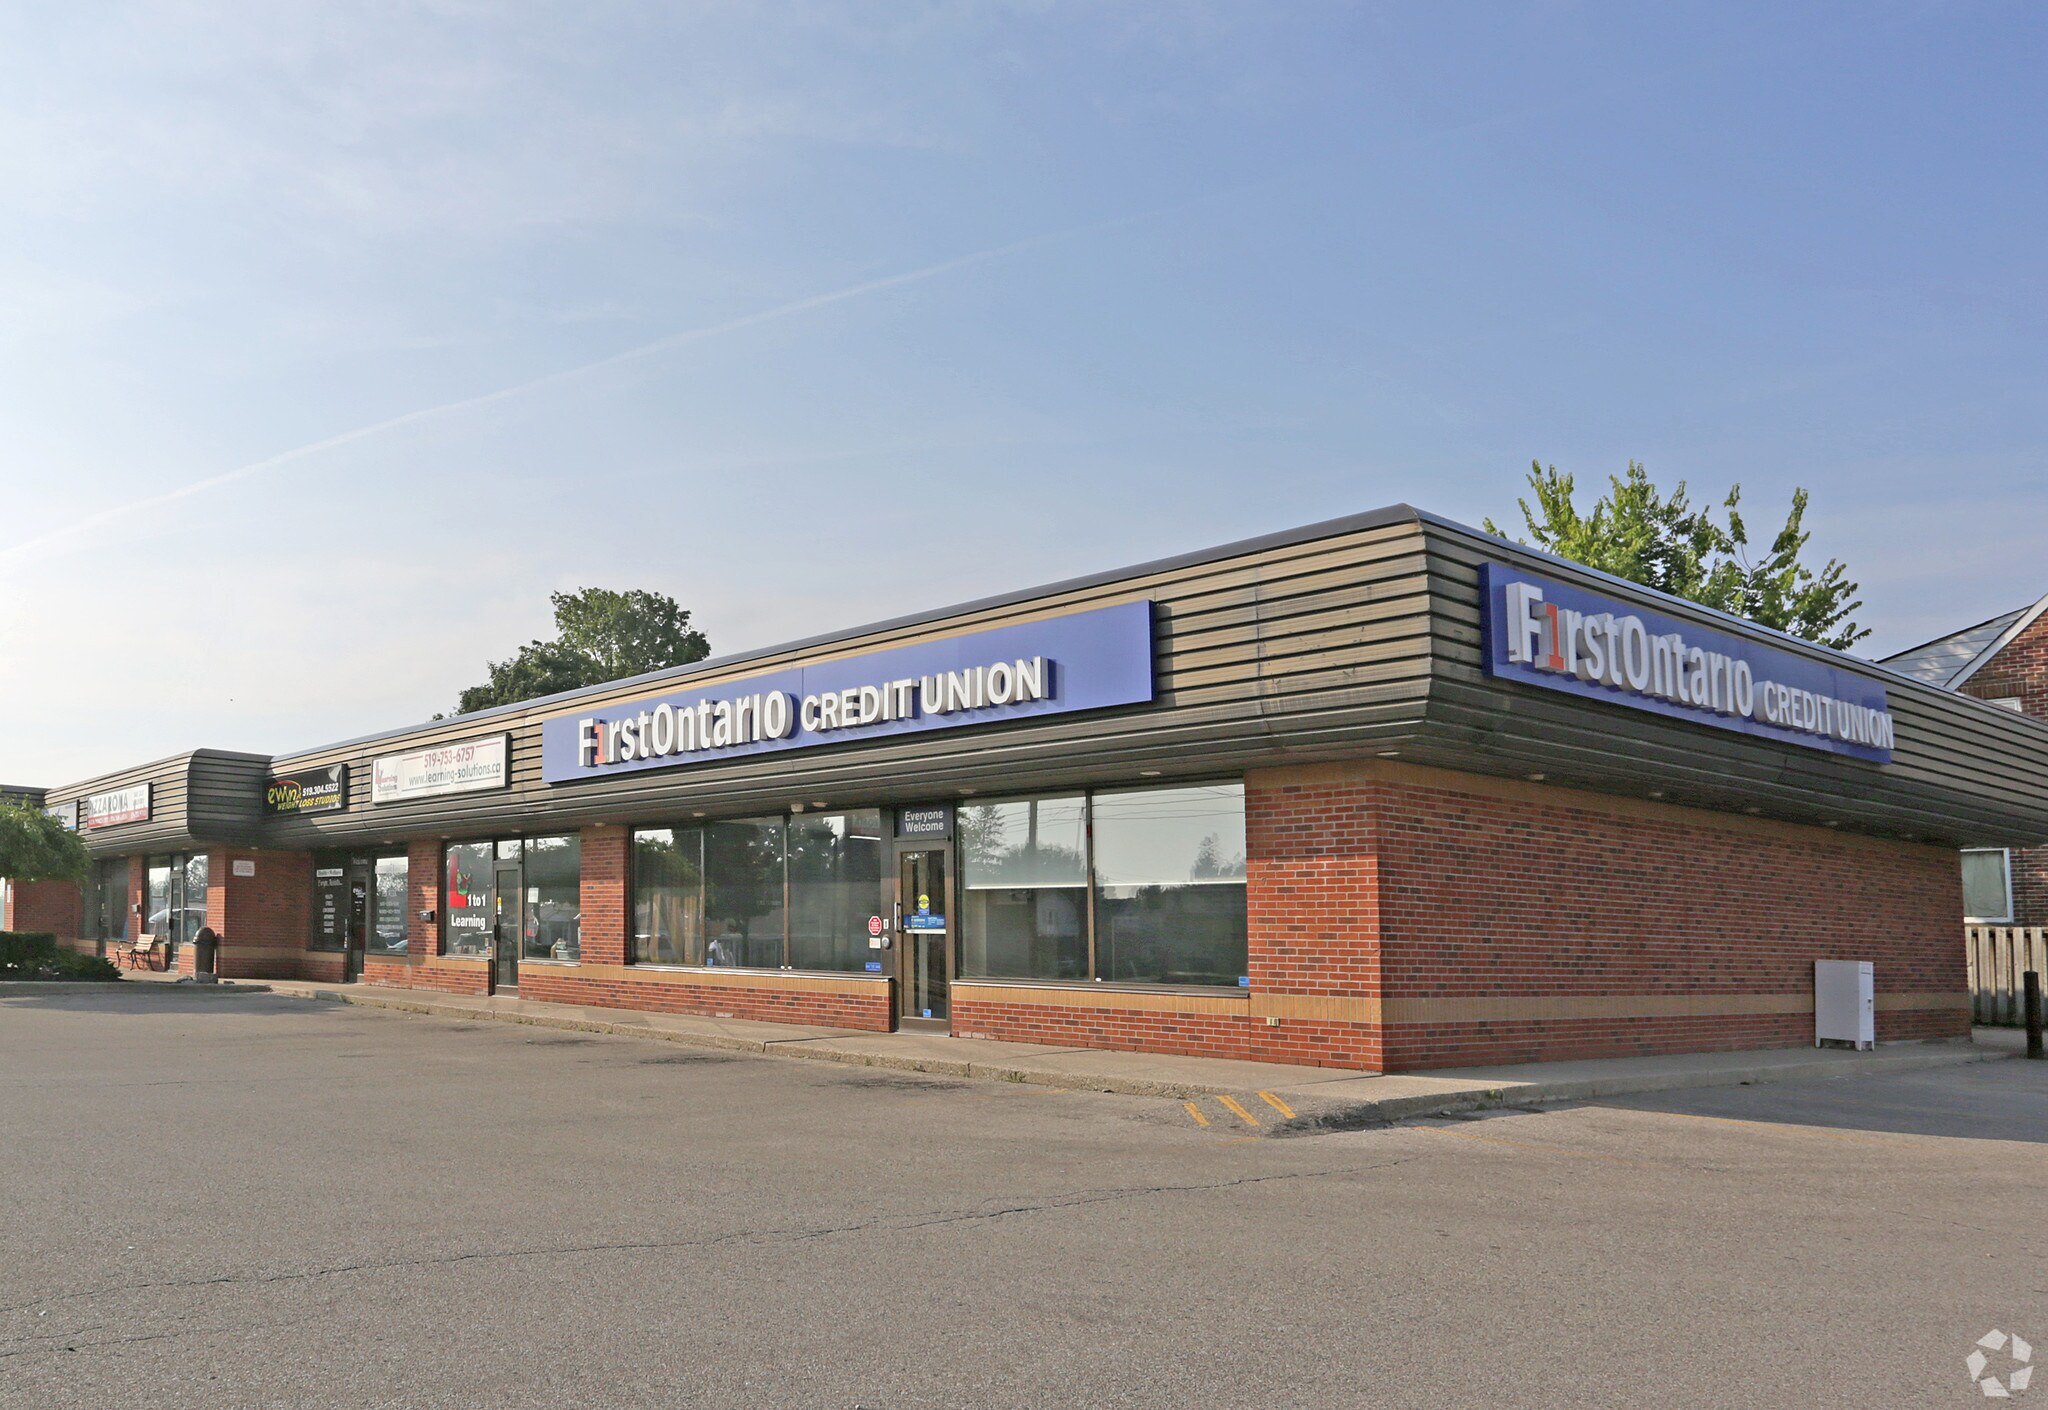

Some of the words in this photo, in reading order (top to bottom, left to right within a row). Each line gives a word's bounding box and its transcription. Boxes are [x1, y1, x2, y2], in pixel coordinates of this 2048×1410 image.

[800, 677, 918, 732] CREDIT
[920, 656, 1049, 715] UNION
[1757, 680, 1833, 735] CREDIT
[1832, 700, 1895, 750] UNION
[424, 746, 475, 768] 519-753-6757
[408, 762, 501, 785] www.learning-solutions.ca
[302, 782, 339, 797] 519.304.5522
[277, 799, 299, 811] WEIGHT
[299, 797, 315, 808] LOSS
[314, 793, 341, 806] STUDIOS
[904, 810, 944, 823] Everyone
[905, 821, 944, 833] Welcome
[467, 894, 473, 907] 1
[472, 893, 482, 907] to
[451, 913, 486, 931] Learning
